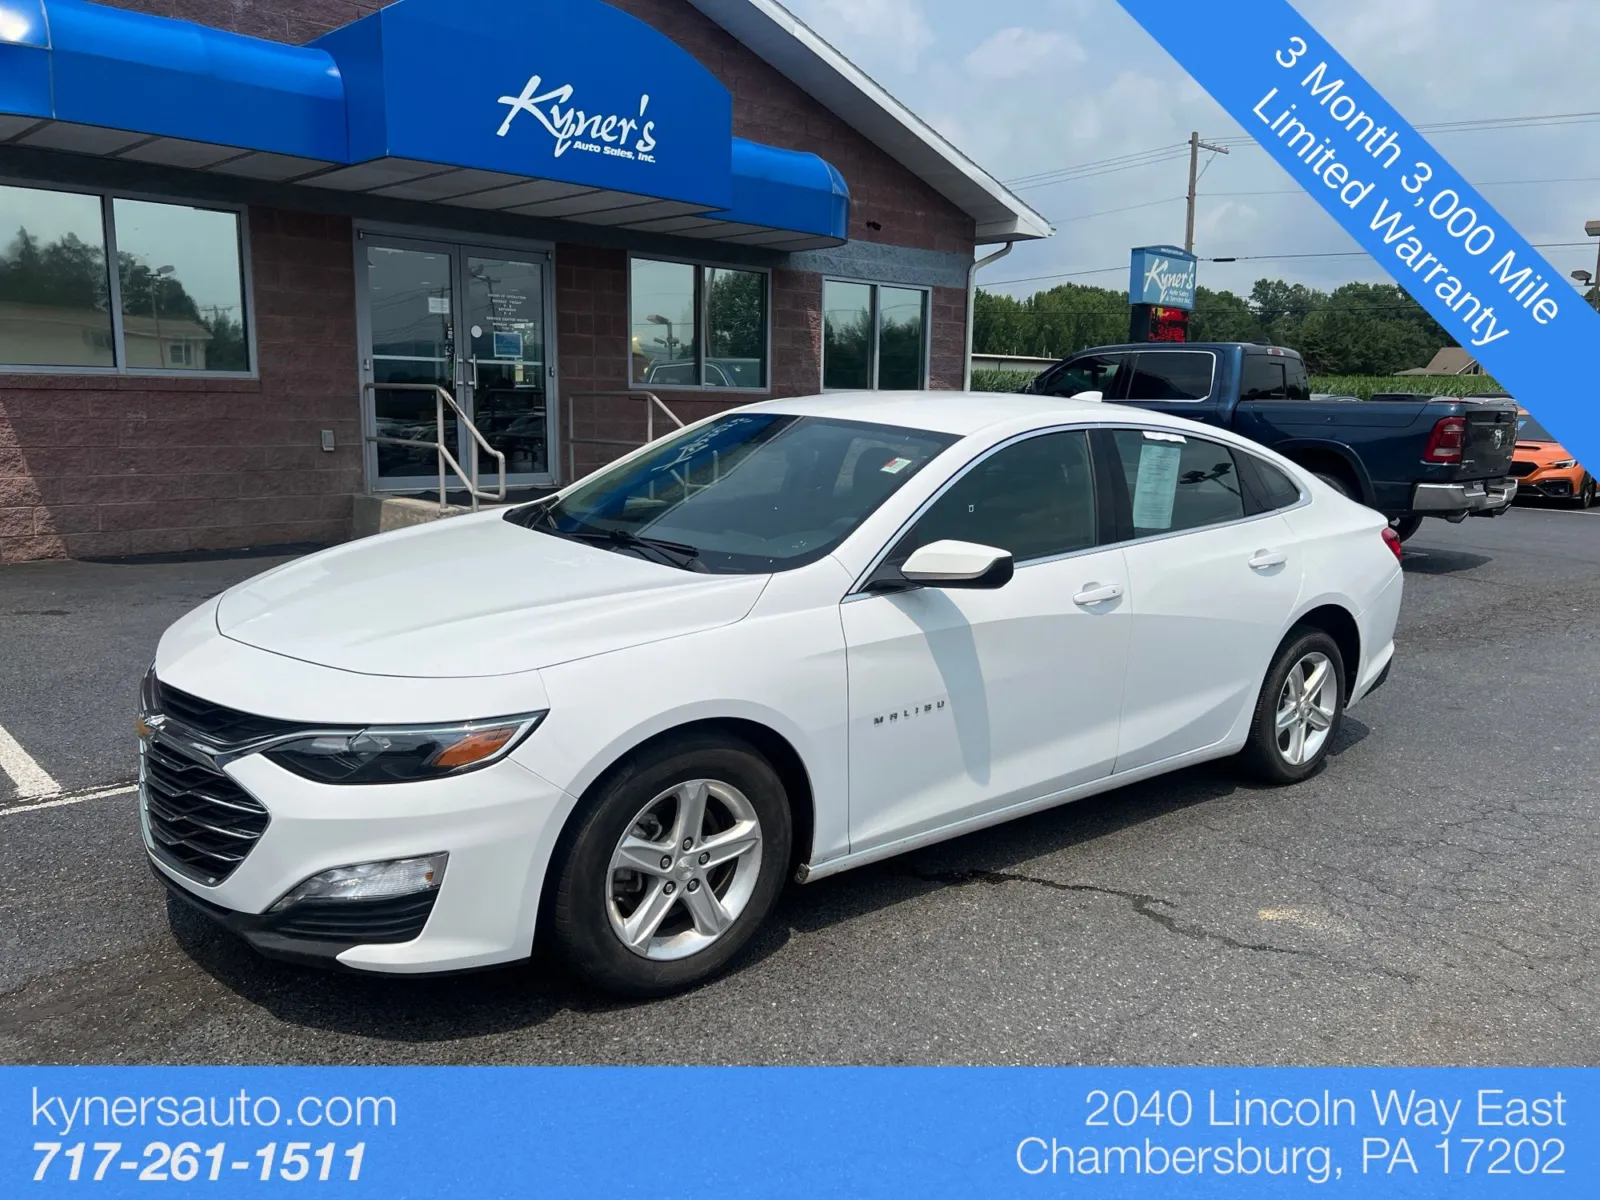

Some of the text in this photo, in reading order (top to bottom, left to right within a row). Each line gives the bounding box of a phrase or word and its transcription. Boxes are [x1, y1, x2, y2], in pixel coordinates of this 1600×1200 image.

[497, 75, 656, 158] Kyner's
[573, 140, 656, 163] Auto Sales, Inc.
[1143, 258, 1194, 304] Kyner's
[873, 700, 945, 725] MALIBU
